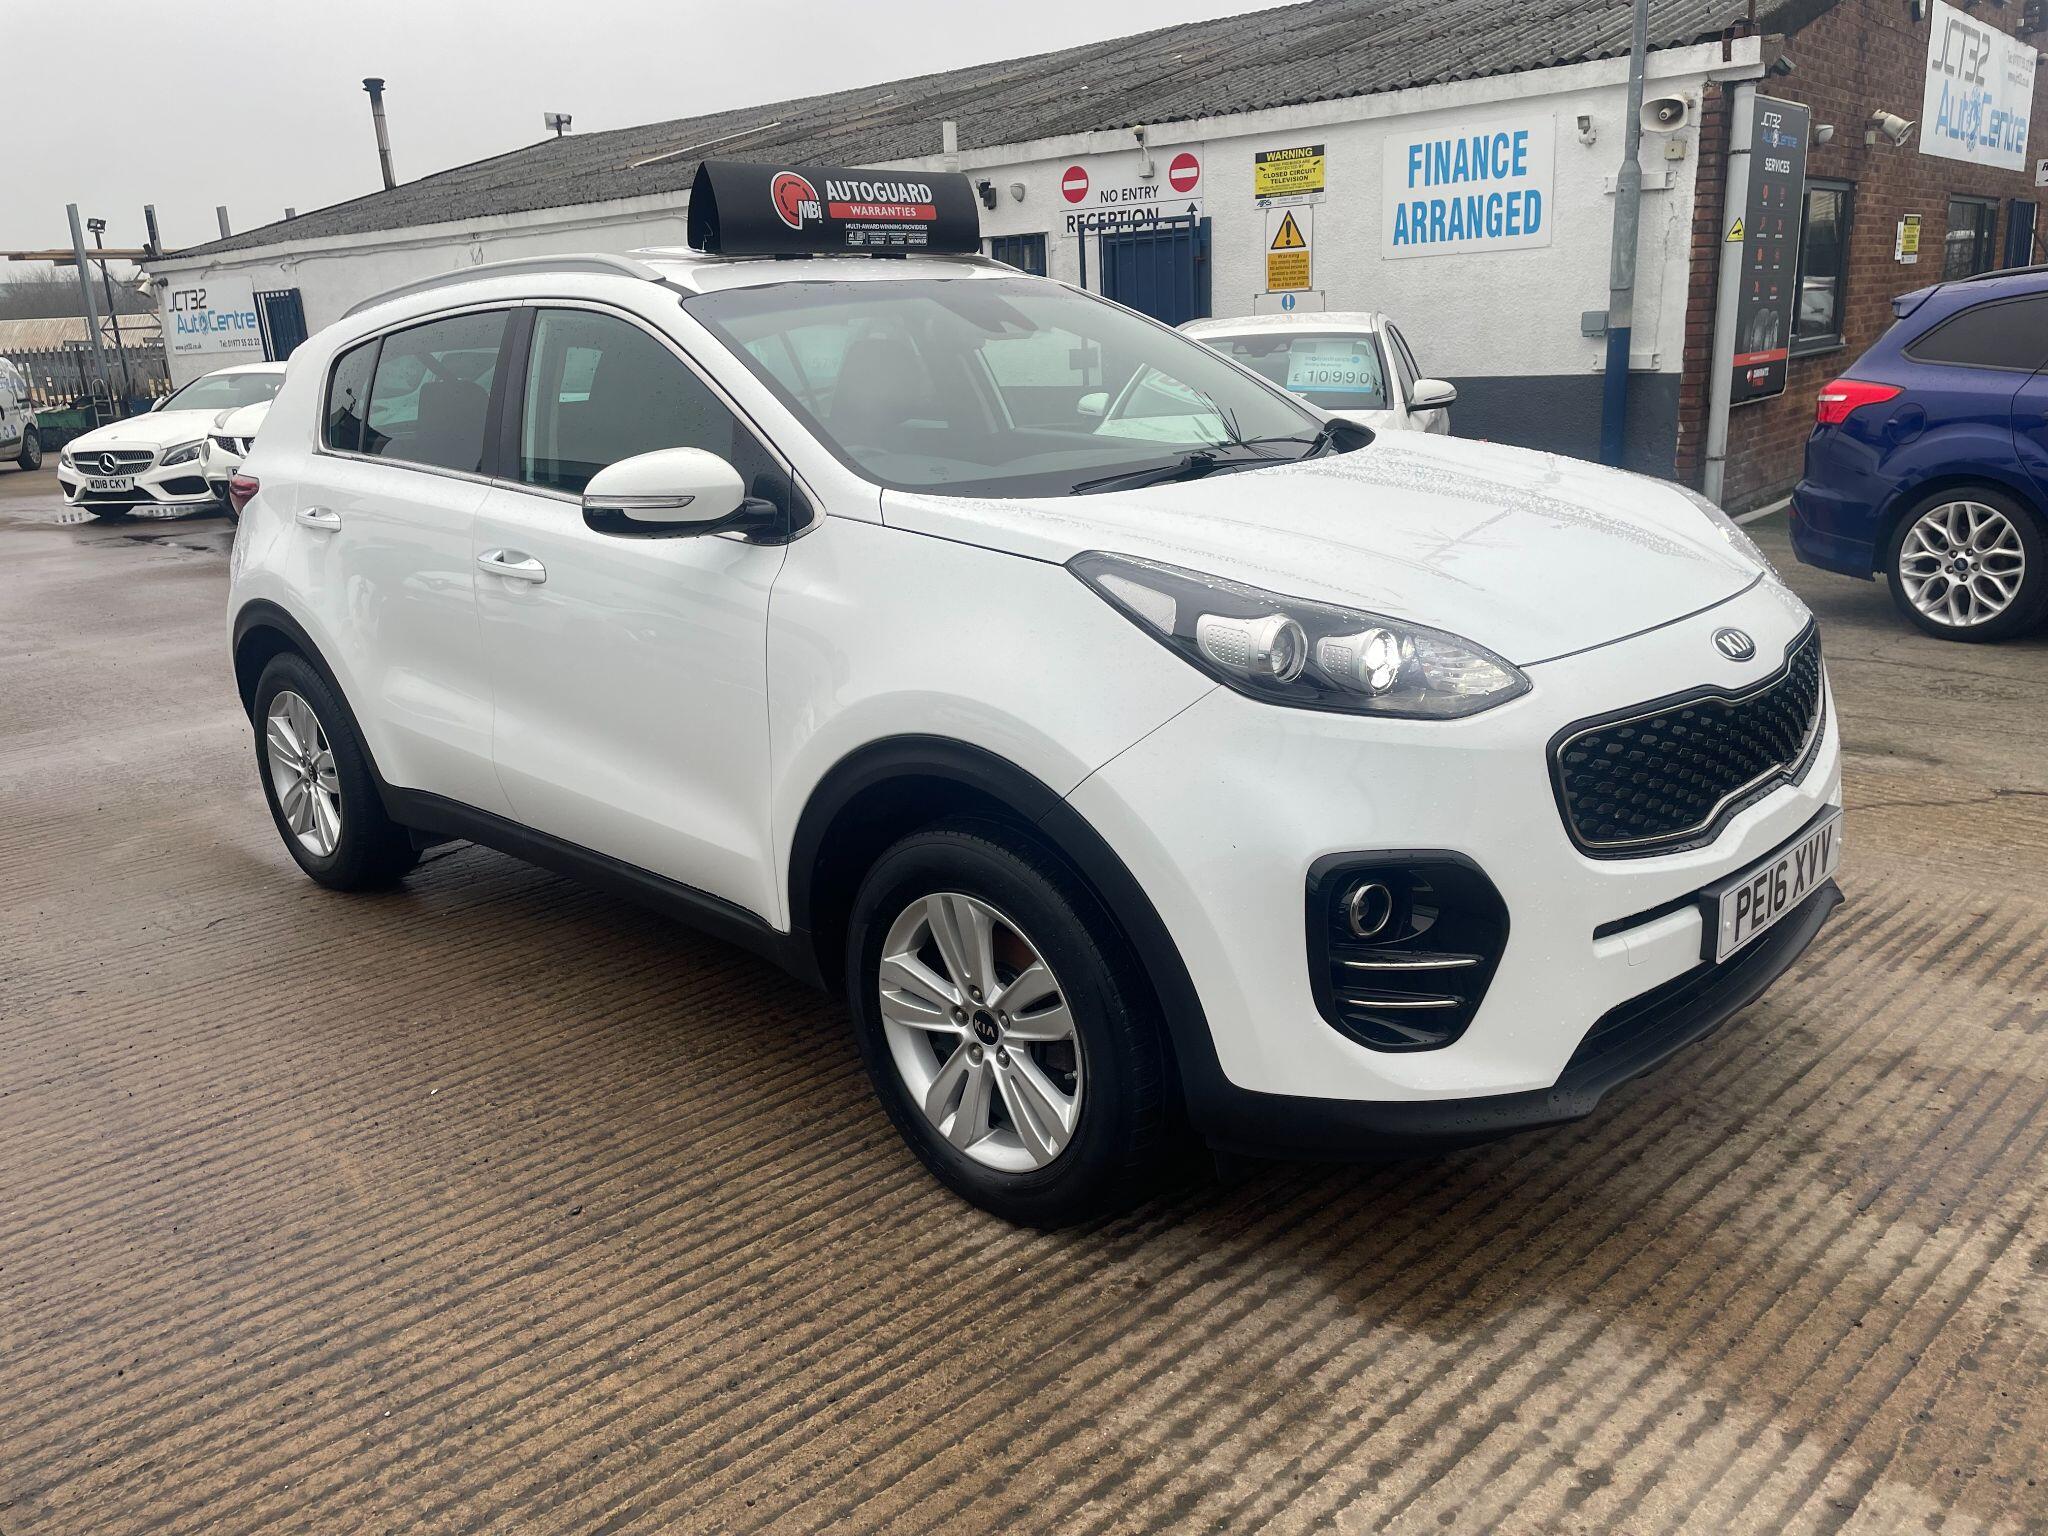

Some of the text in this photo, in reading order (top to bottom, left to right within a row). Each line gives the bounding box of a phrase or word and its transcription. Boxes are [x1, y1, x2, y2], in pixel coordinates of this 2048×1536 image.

[1932, 16, 1991, 87] JCT32
[1266, 147, 1313, 162] WARNING
[1408, 130, 1529, 189] FINANCE
[1262, 168, 1317, 179] CLOSED CIRCUIT
[1764, 157, 1790, 174] SERVICES
[1270, 175, 1309, 184] TELEVISION
[825, 180, 933, 203] AUTOGUARD
[1100, 185, 1160, 203] NO ENTRY
[849, 205, 917, 217] WARRANTIES
[1392, 189, 1542, 246] ARRANGED
[168, 288, 207, 313] JCT32
[177, 309, 257, 336] AutoCentre
[241, 338, 247, 347] 55
[247, 338, 254, 347] 22
[254, 337, 261, 346] 22
[1293, 370, 1370, 384] £ 10990
[89, 477, 128, 489] WD18 CKY
[1734, 825, 1833, 942] PE16 XVV
[974, 1018, 995, 1038] KIA
